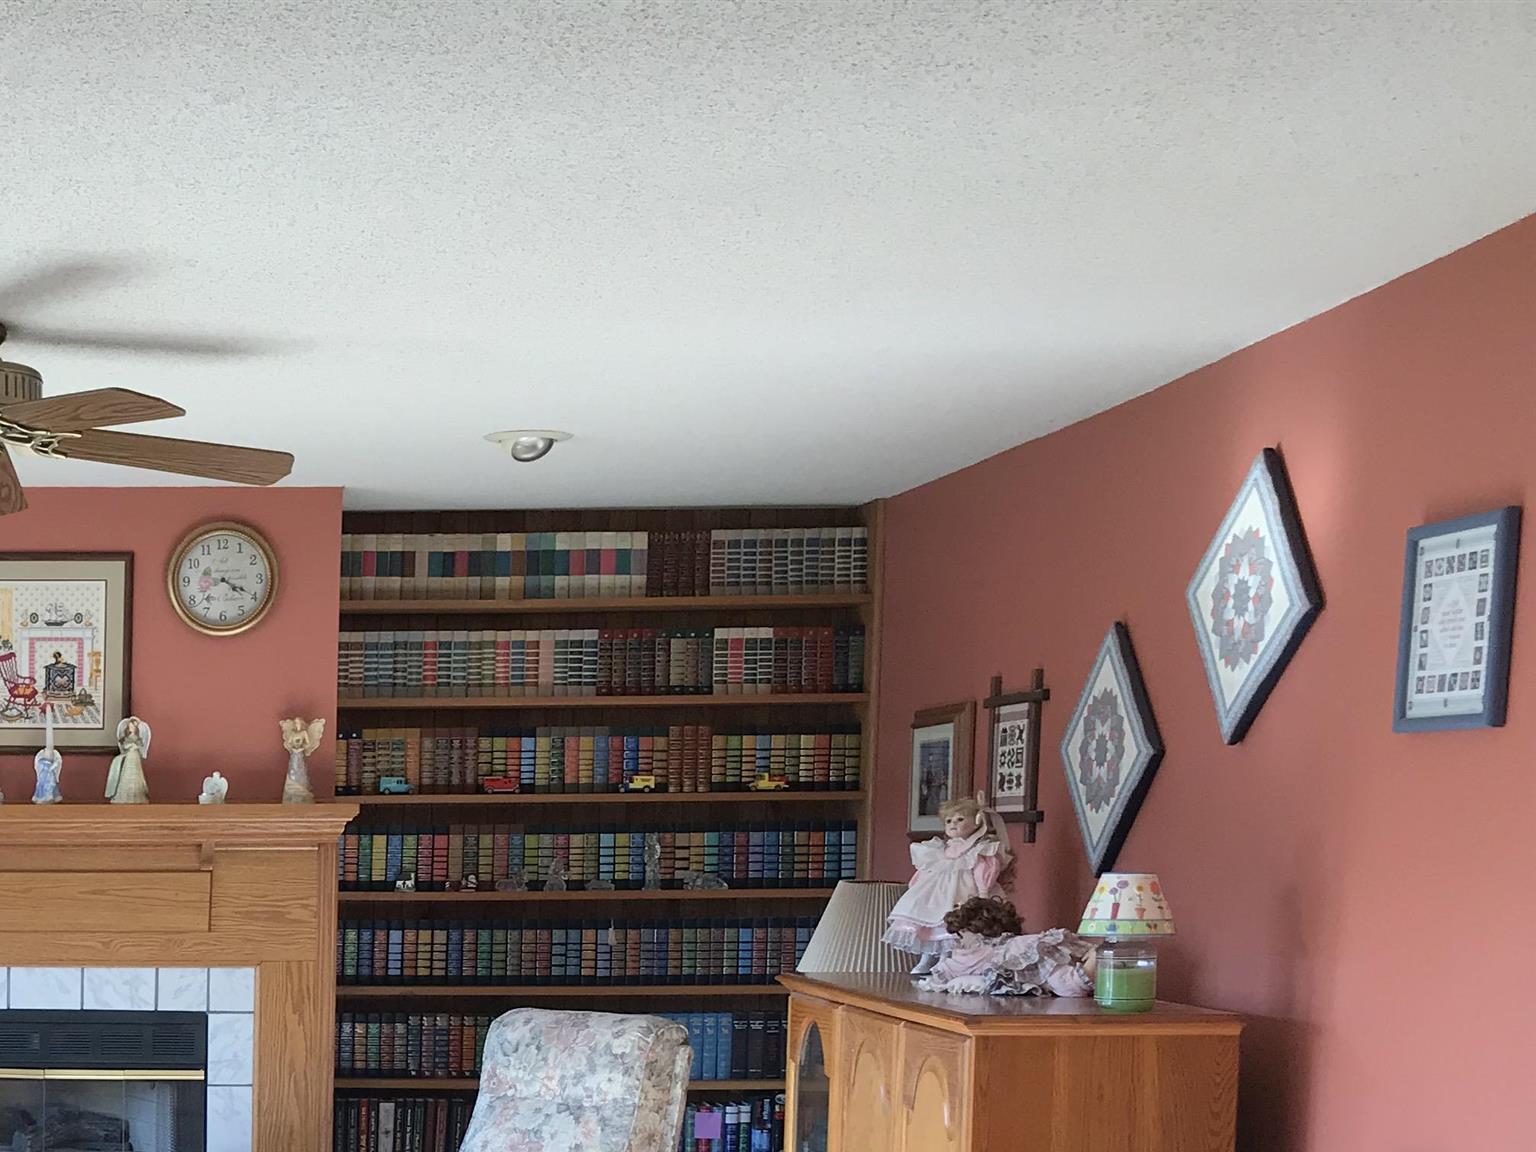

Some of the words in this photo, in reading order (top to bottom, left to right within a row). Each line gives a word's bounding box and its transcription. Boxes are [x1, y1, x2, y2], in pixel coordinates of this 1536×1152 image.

[201, 544, 211, 555] 11
[217, 538, 229, 550] 12
[236, 543, 243, 553] 1
[188, 558, 199, 569] 10
[250, 555, 257, 565] 2
[183, 576, 190, 587] 9
[256, 573, 263, 584] 3
[189, 594, 196, 606] 8
[203, 607, 210, 617] 7
[238, 605, 245, 616] 5
[219, 611, 227, 622] 6
